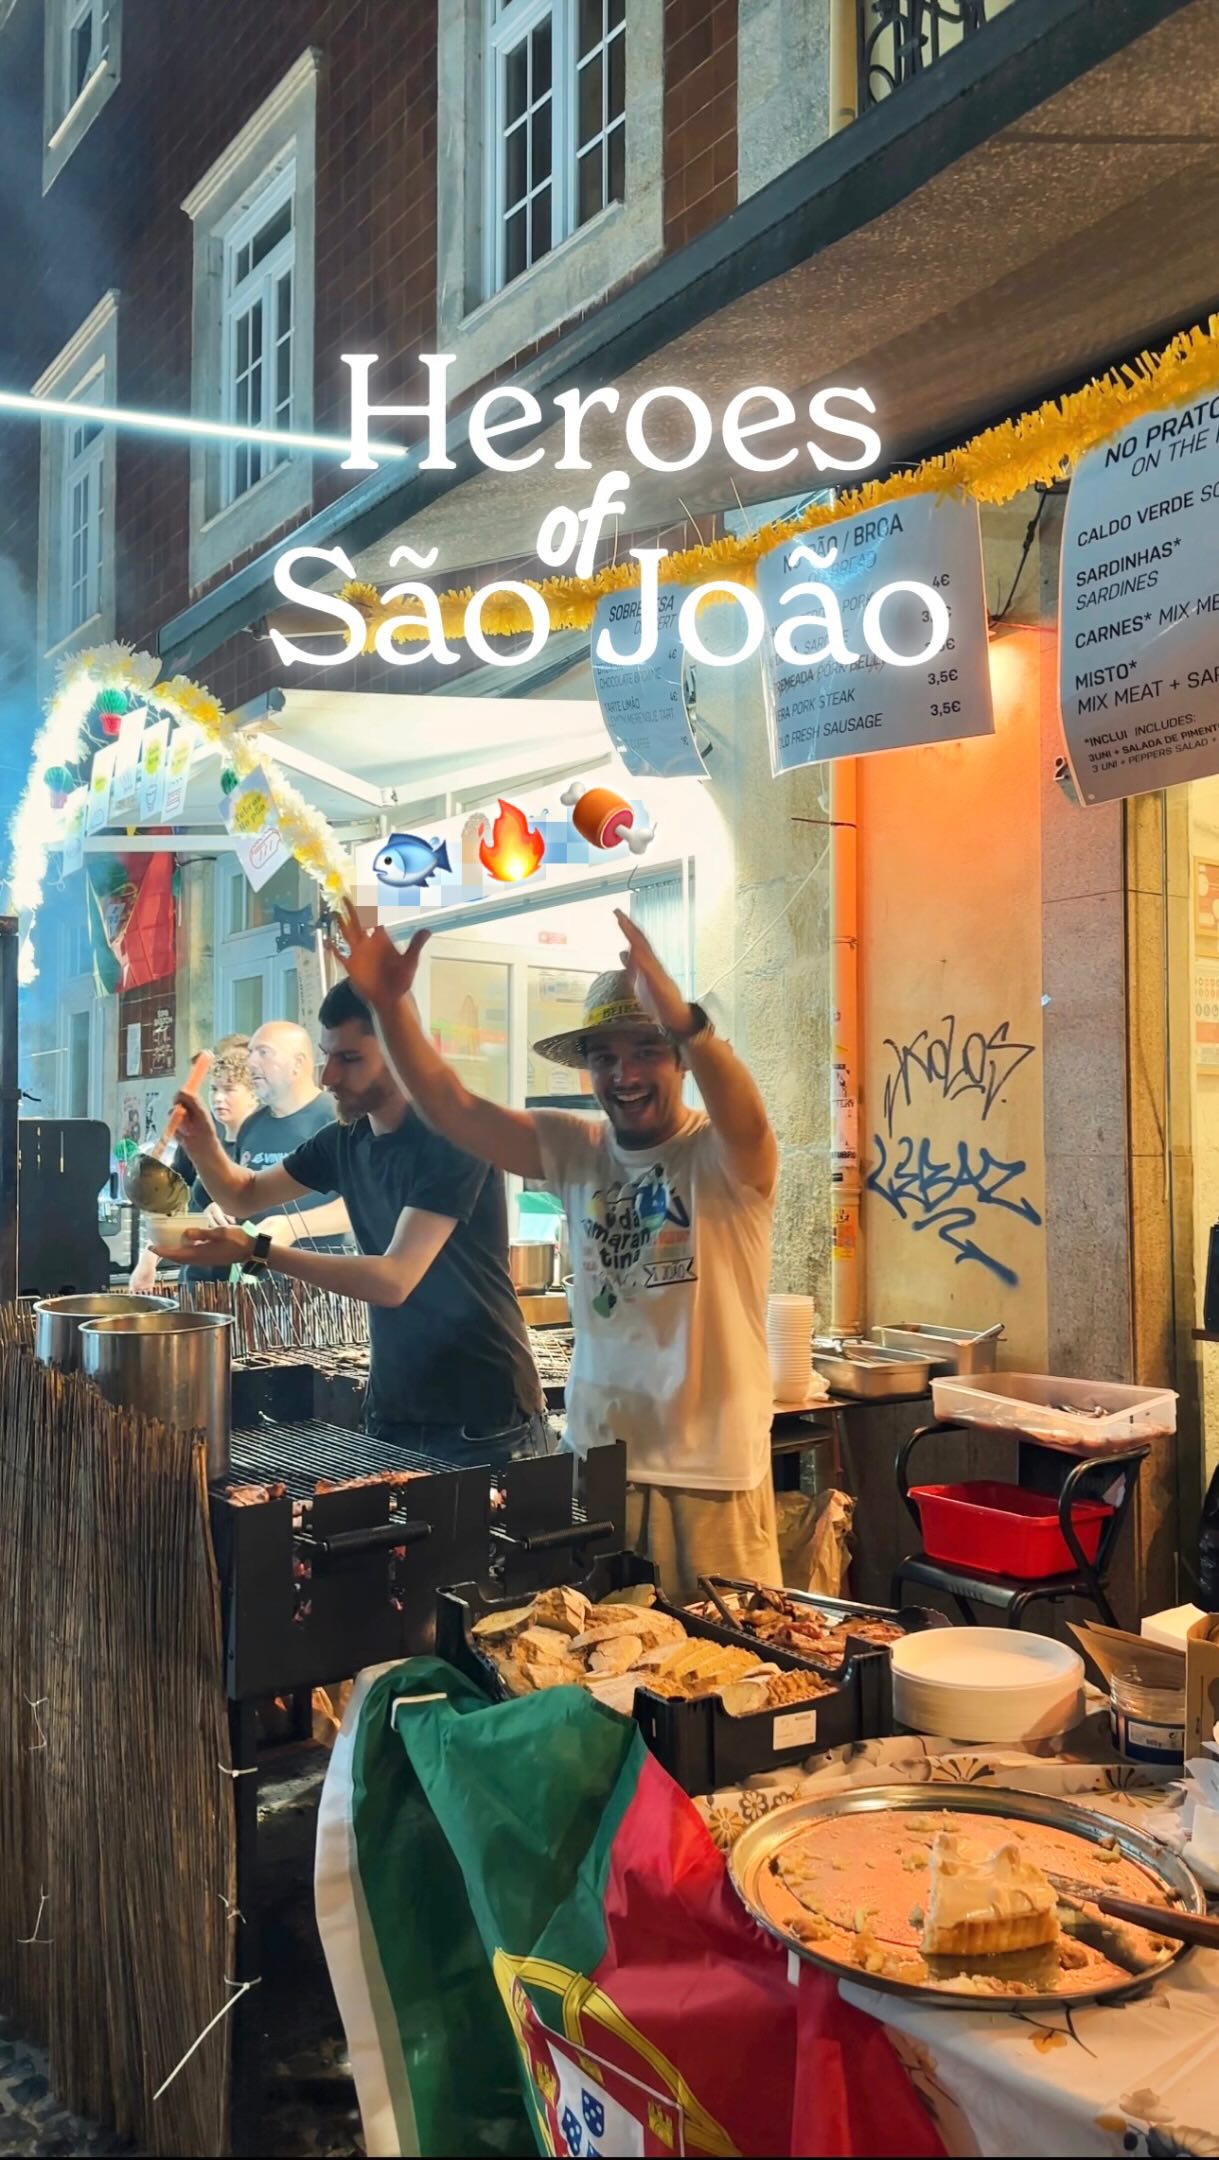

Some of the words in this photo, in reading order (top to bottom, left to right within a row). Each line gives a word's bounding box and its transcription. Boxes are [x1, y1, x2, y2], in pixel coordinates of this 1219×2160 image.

[1104, 436, 1137, 468] NO
[1131, 449, 1162, 477] ON
[1169, 428, 1210, 462] THE
[854, 513, 904, 547] BROA
[1077, 514, 1131, 547] CALDO
[1137, 491, 1194, 524] VERDE
[932, 574, 950, 588] 4€
[1076, 570, 1159, 611] SARDINES
[609, 595, 675, 622] SOBRESA
[1159, 601, 1190, 625] MIX
[819, 687, 856, 708] STEAK
[927, 669, 959, 685] 3,5€
[1078, 693, 1108, 715] MIX
[1115, 680, 1163, 707] MEAT
[1170, 679, 1180, 690] +
[791, 724, 820, 744] FRESH
[823, 713, 883, 736] SAUSAGE
[930, 700, 961, 717] 3,5€
[1134, 713, 1197, 736] INCLUDES:
[1101, 761, 1118, 772] UNI
[1128, 746, 1173, 765] PEPPERS
[1175, 738, 1209, 753] SALAD
[1122, 737, 1163, 754] SALADA
[1164, 733, 1178, 745] DE
